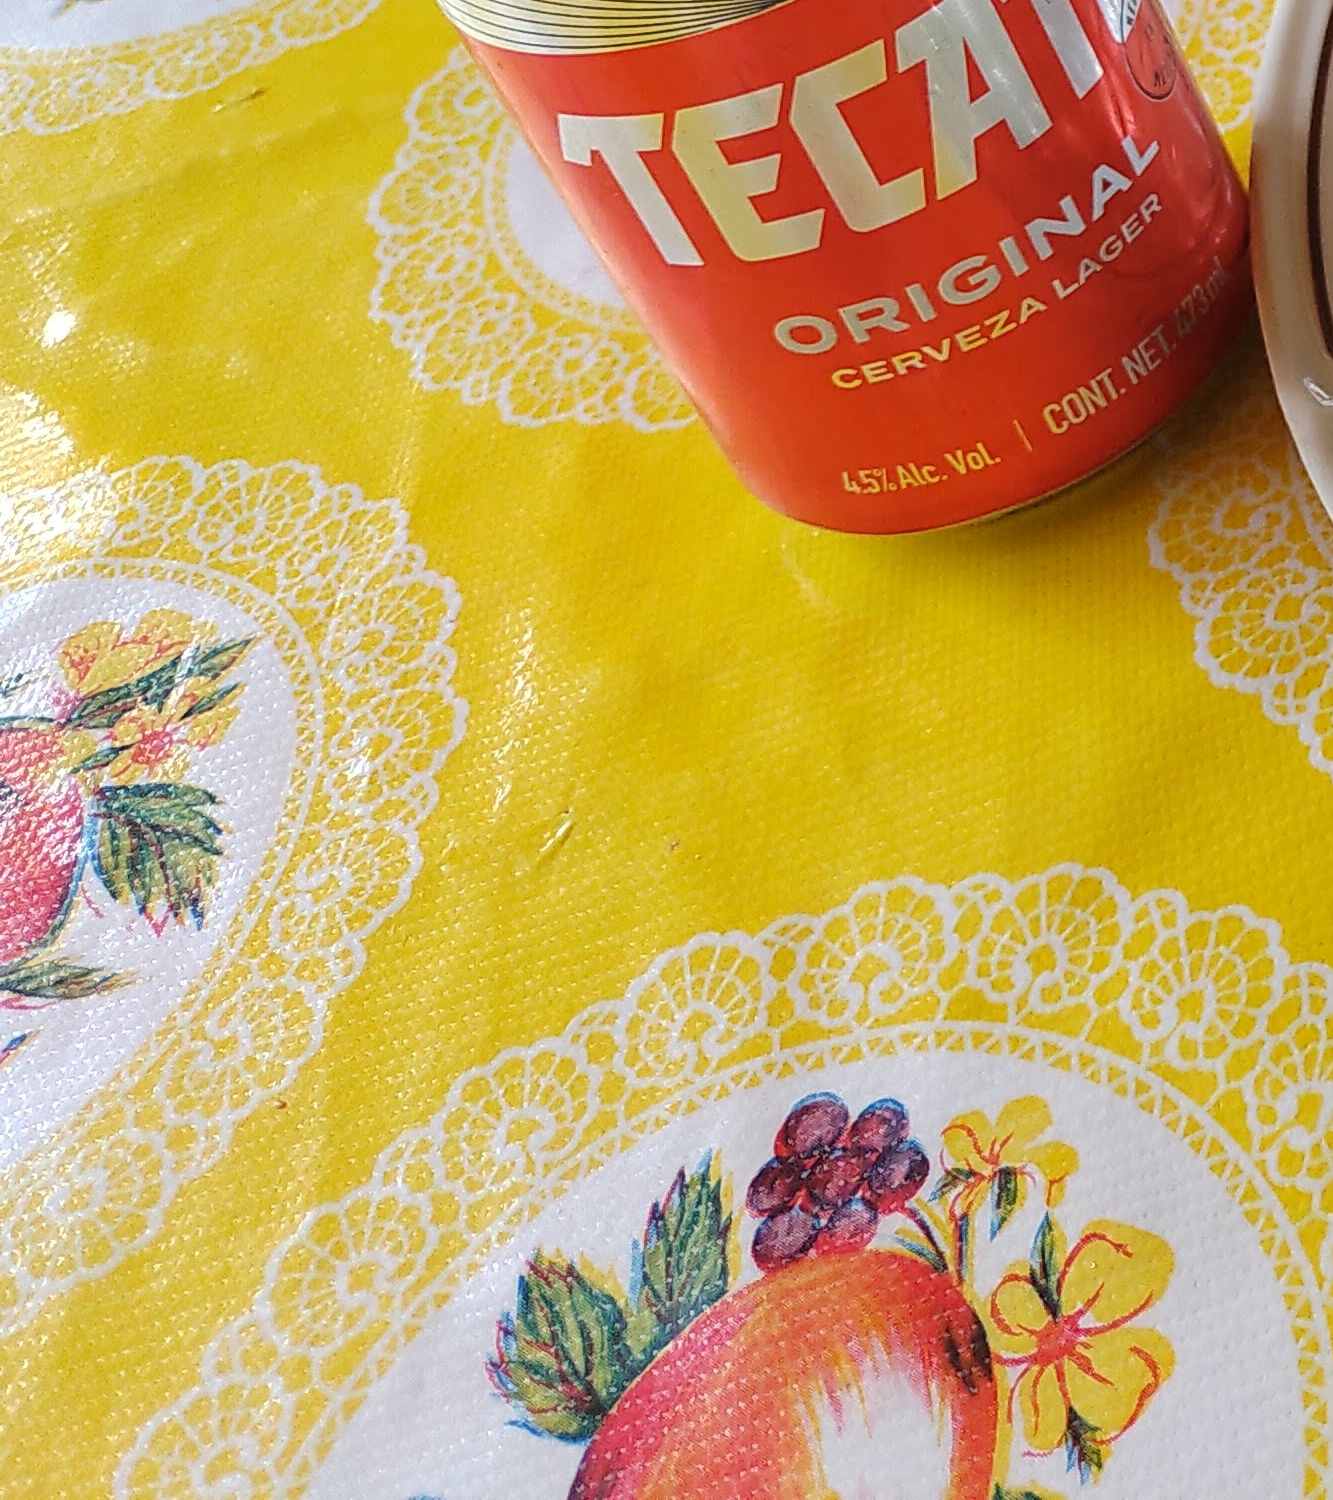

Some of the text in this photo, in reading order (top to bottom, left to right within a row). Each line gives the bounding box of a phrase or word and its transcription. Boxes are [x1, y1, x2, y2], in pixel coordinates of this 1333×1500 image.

[774, 135, 1160, 355] ORIGINAL
[831, 193, 1163, 390] CERVEZA LAGER
[943, 441, 1003, 476] Vol.
[1042, 366, 1127, 435] CONT.
[1121, 324, 1177, 386] NET.
